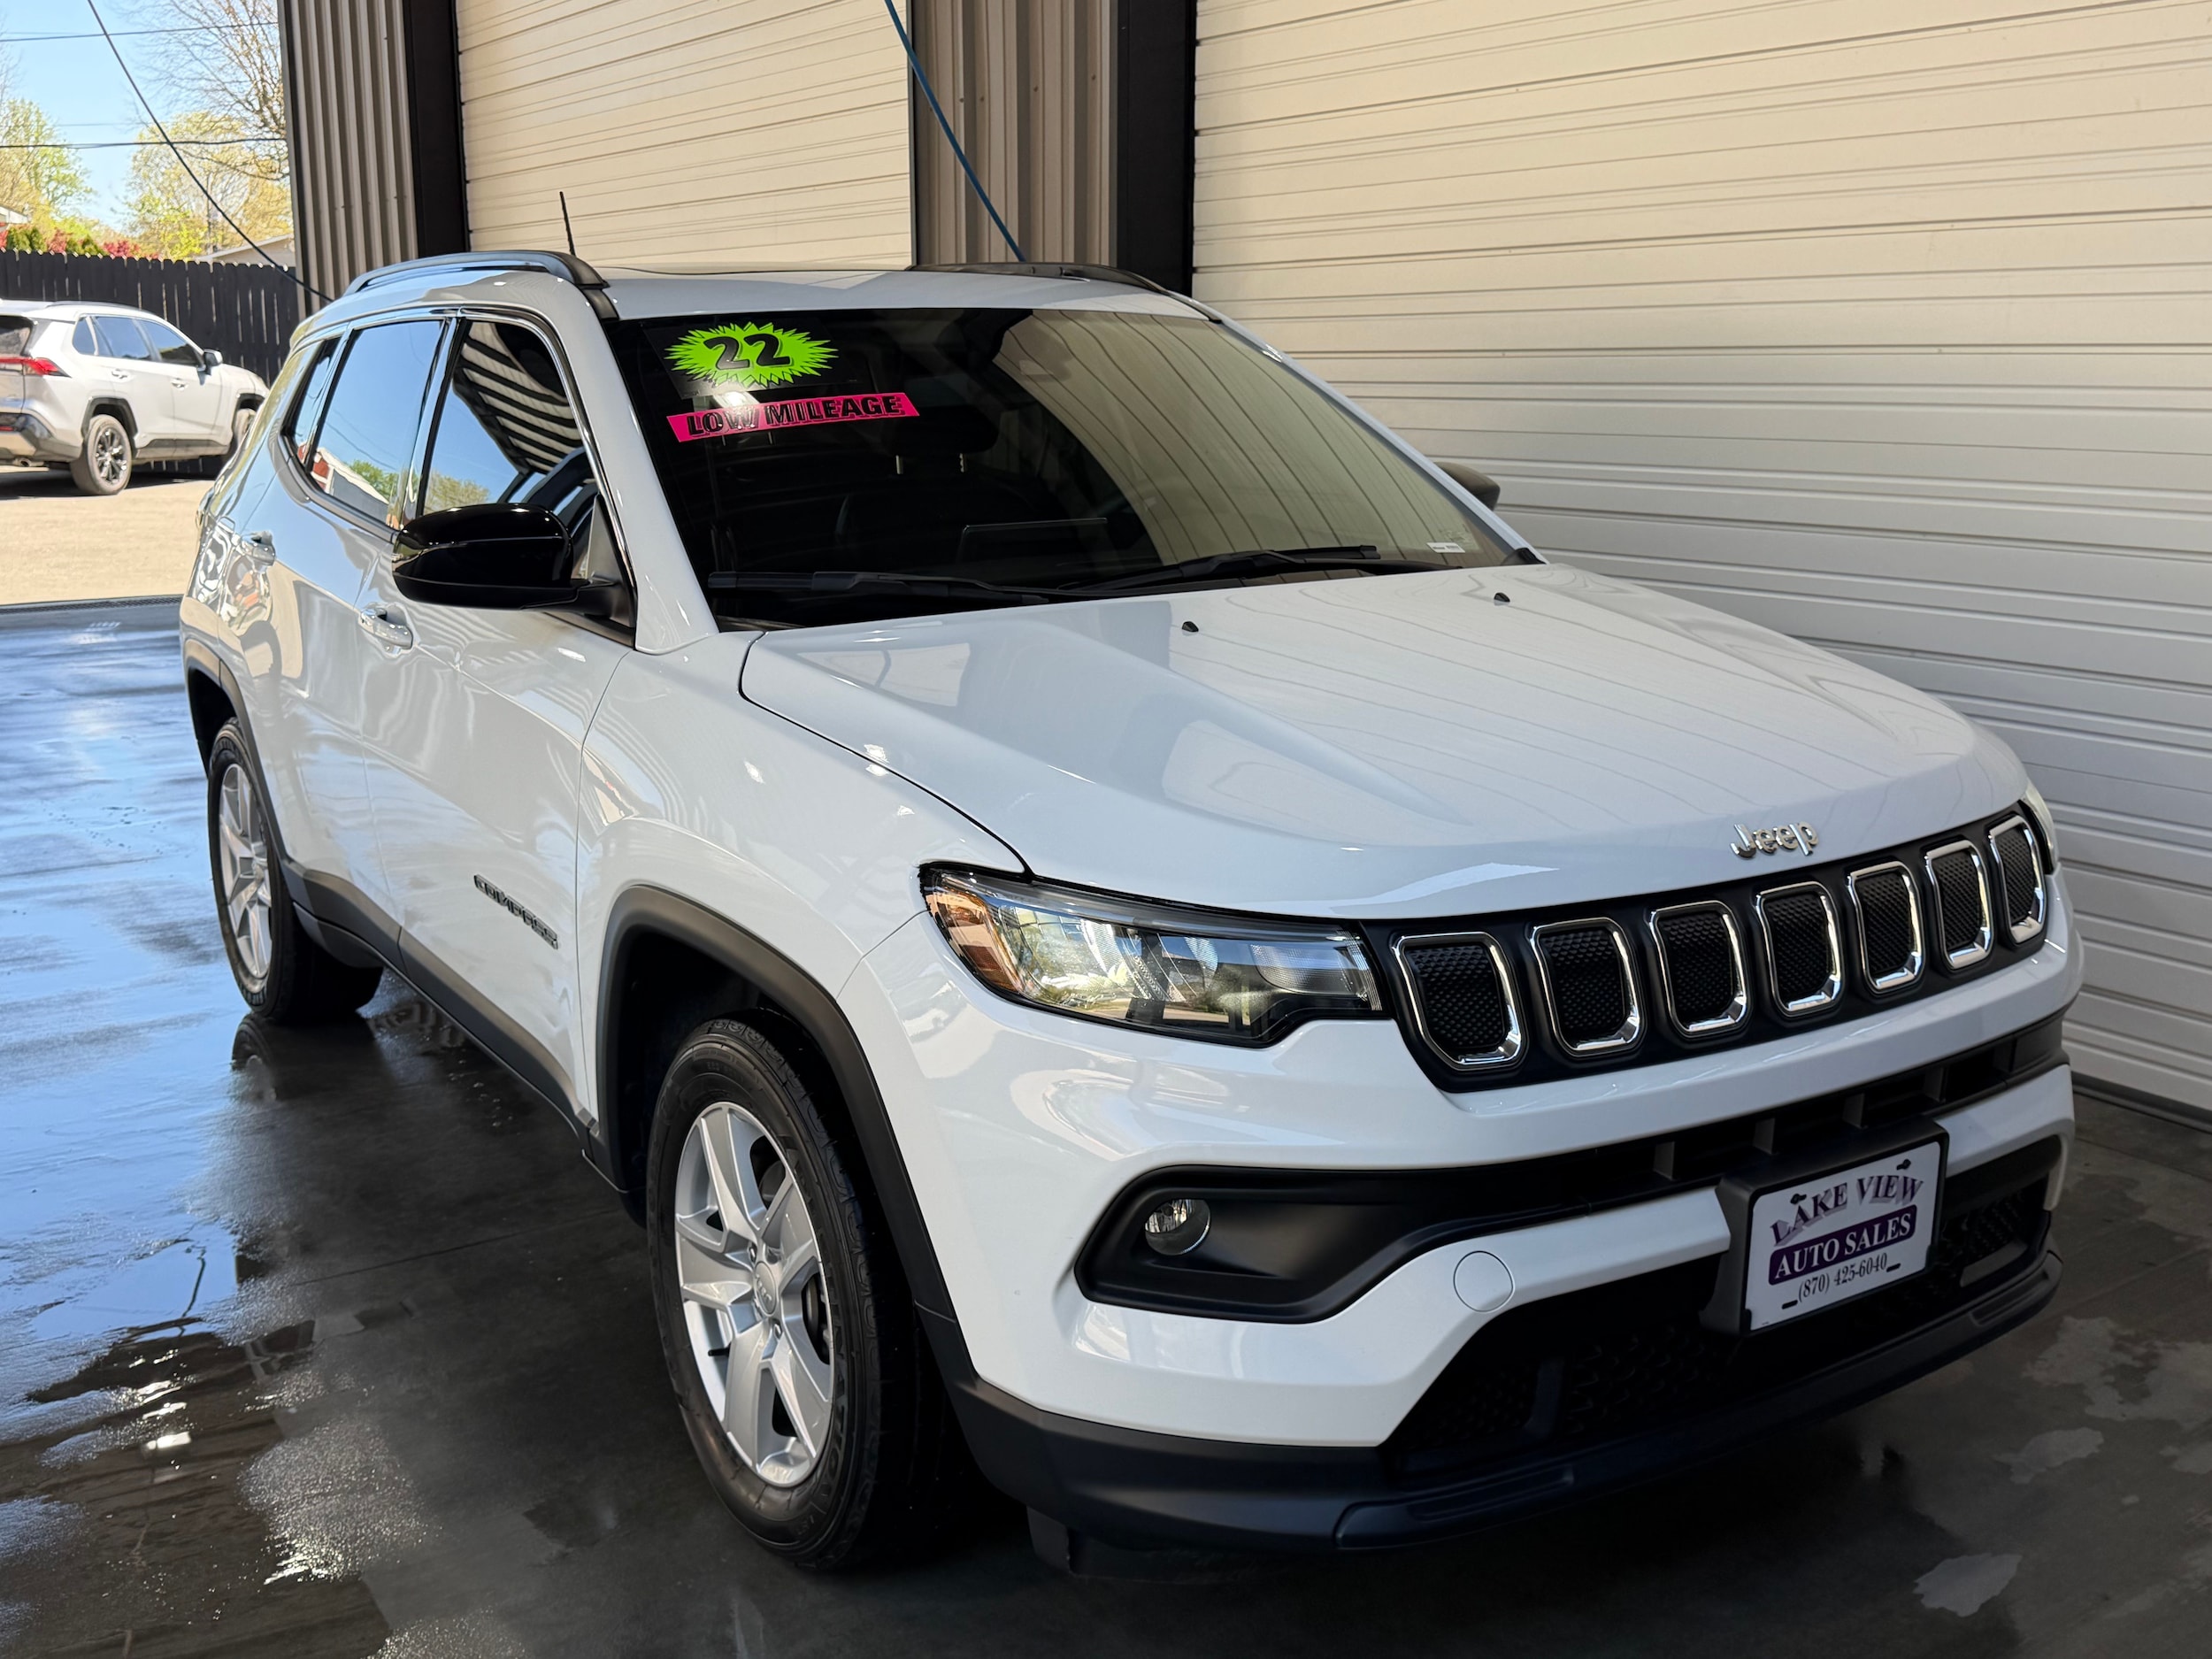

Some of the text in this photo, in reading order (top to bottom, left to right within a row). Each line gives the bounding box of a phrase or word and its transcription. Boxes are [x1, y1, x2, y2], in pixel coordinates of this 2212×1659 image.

[703, 334, 793, 371] 22
[687, 396, 904, 436] LOW MILEAGE
[1729, 821, 1819, 860] Jeep
[1770, 1175, 1924, 1247] LAKE VIEW
[1775, 1213, 1911, 1279] AUTO SALES
[1798, 1252, 1887, 1302] (870) 425-6040
